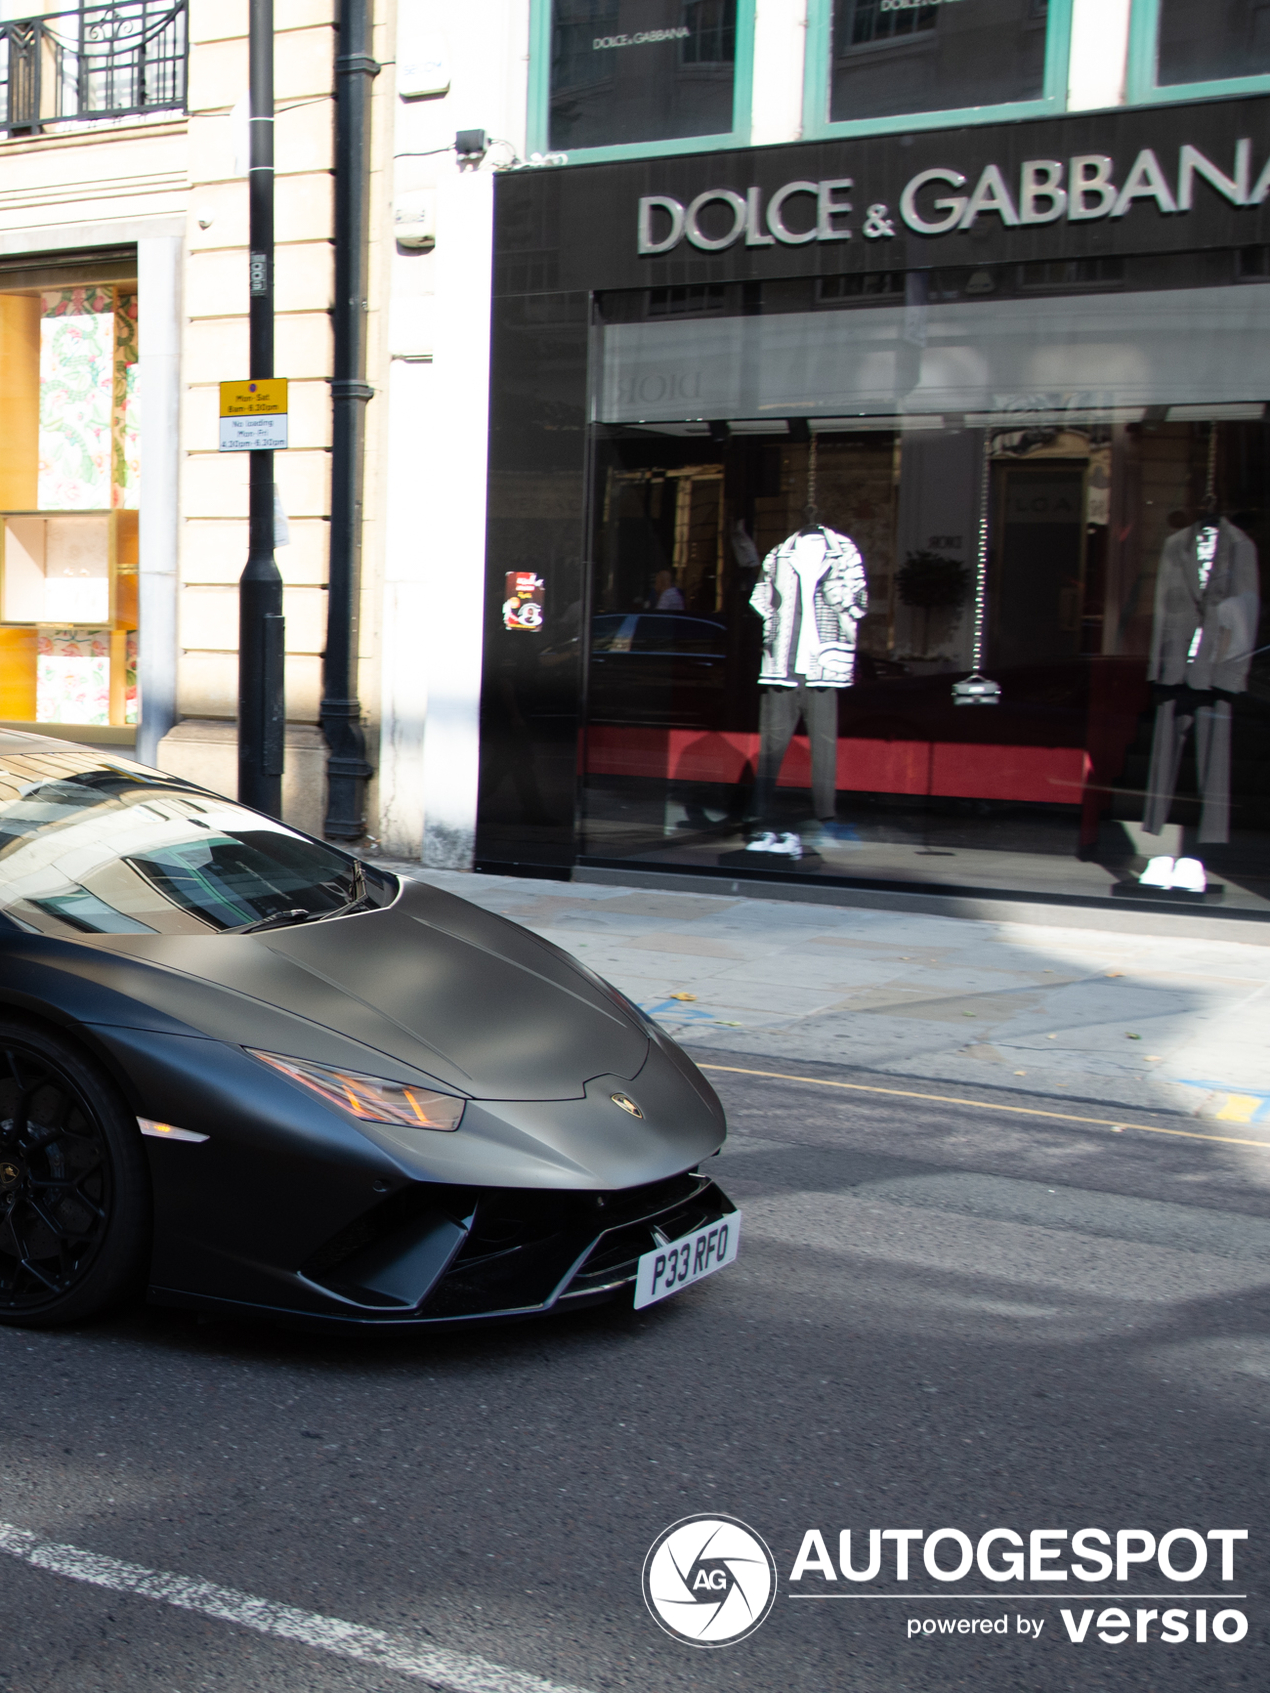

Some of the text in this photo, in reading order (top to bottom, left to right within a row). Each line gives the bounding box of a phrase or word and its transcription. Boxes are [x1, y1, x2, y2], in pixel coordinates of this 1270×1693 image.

[593, 34, 628, 50] DOLCE
[632, 27, 690, 44] GABBANA
[638, 178, 853, 256] DOLCE
[862, 203, 896, 238] &
[651, 1242, 692, 1296] P33
